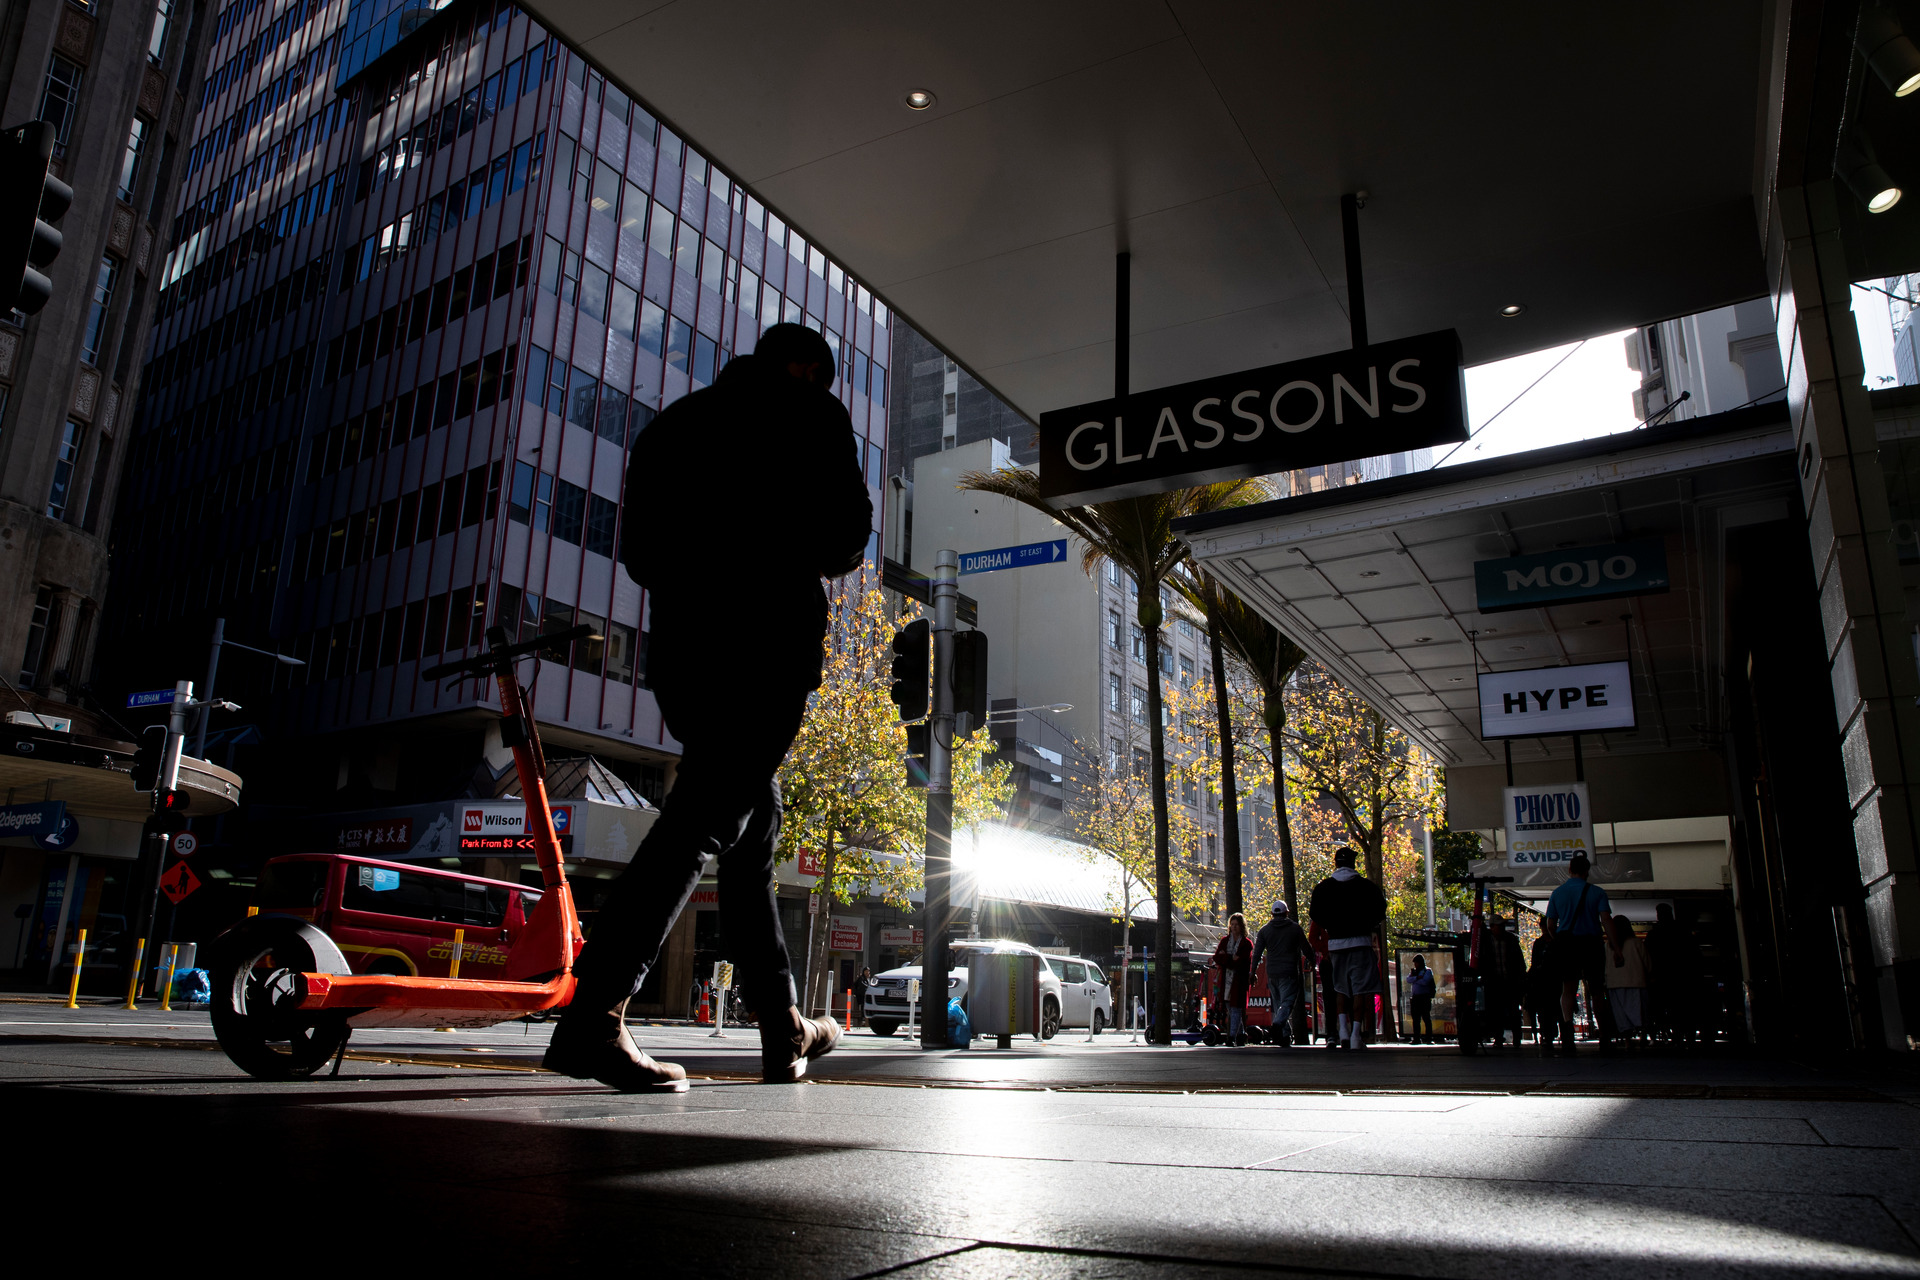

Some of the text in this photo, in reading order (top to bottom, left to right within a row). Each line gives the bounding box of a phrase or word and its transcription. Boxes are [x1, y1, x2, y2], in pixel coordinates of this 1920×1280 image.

[1065, 358, 1427, 472] GLASSONS
[966, 547, 1043, 571] DURHAM ST EAST
[1502, 555, 1637, 591] MOJO
[137, 693, 160, 704] DURHAM
[1503, 685, 1608, 714] HYPE
[1513, 792, 1581, 824] PHOTO
[0, 811, 42, 831] 2degrees
[485, 815, 522, 826] Wilson
[1517, 822, 1582, 831] WAREHOUSE
[346, 829, 364, 841] CTS
[177, 839, 193, 849] 50
[461, 837, 514, 849] Park From $3
[1512, 838, 1586, 852] CAMERA
[834, 931, 859, 941] Currency
[834, 940, 860, 949] Exchange
